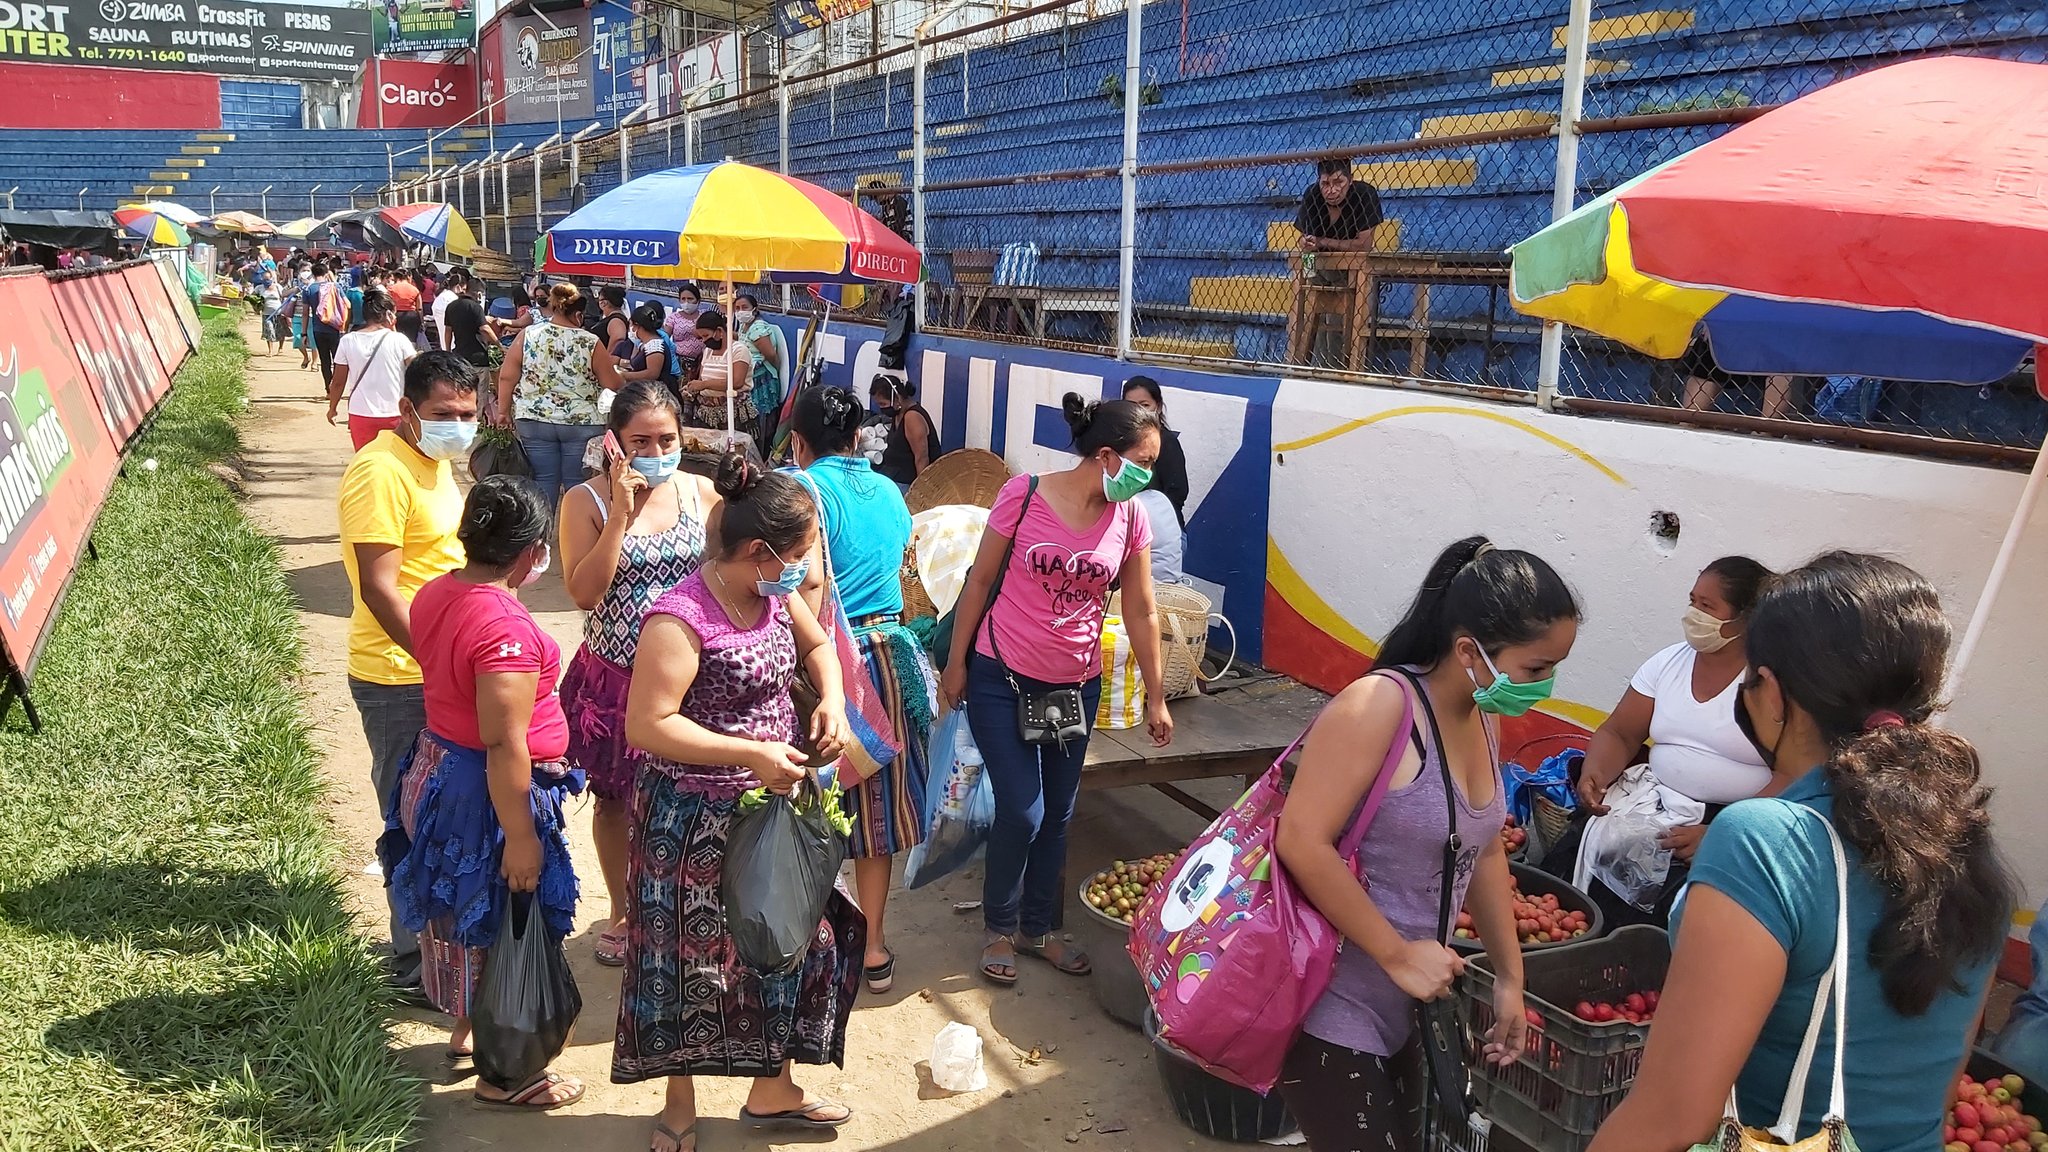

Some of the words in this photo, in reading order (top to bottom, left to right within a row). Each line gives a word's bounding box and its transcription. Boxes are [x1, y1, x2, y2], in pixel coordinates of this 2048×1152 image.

[128, 2, 186, 22] ZUMBA
[200, 4, 266, 27] CrossFit
[284, 12, 331, 31] PESAS
[88, 27, 150, 43] SAUNA
[171, 30, 251, 48] RUTINAS
[78, 47, 103, 59] Tel.
[108, 48, 185, 62] 7791-1640
[282, 40, 354, 57] SPINNING
[198, 54, 256, 66] sportcenter
[381, 83, 444, 107] Claro
[574, 238, 664, 259] DIRECT
[857, 251, 908, 275] DIRECT
[1032, 552, 1111, 587] HAPPY
